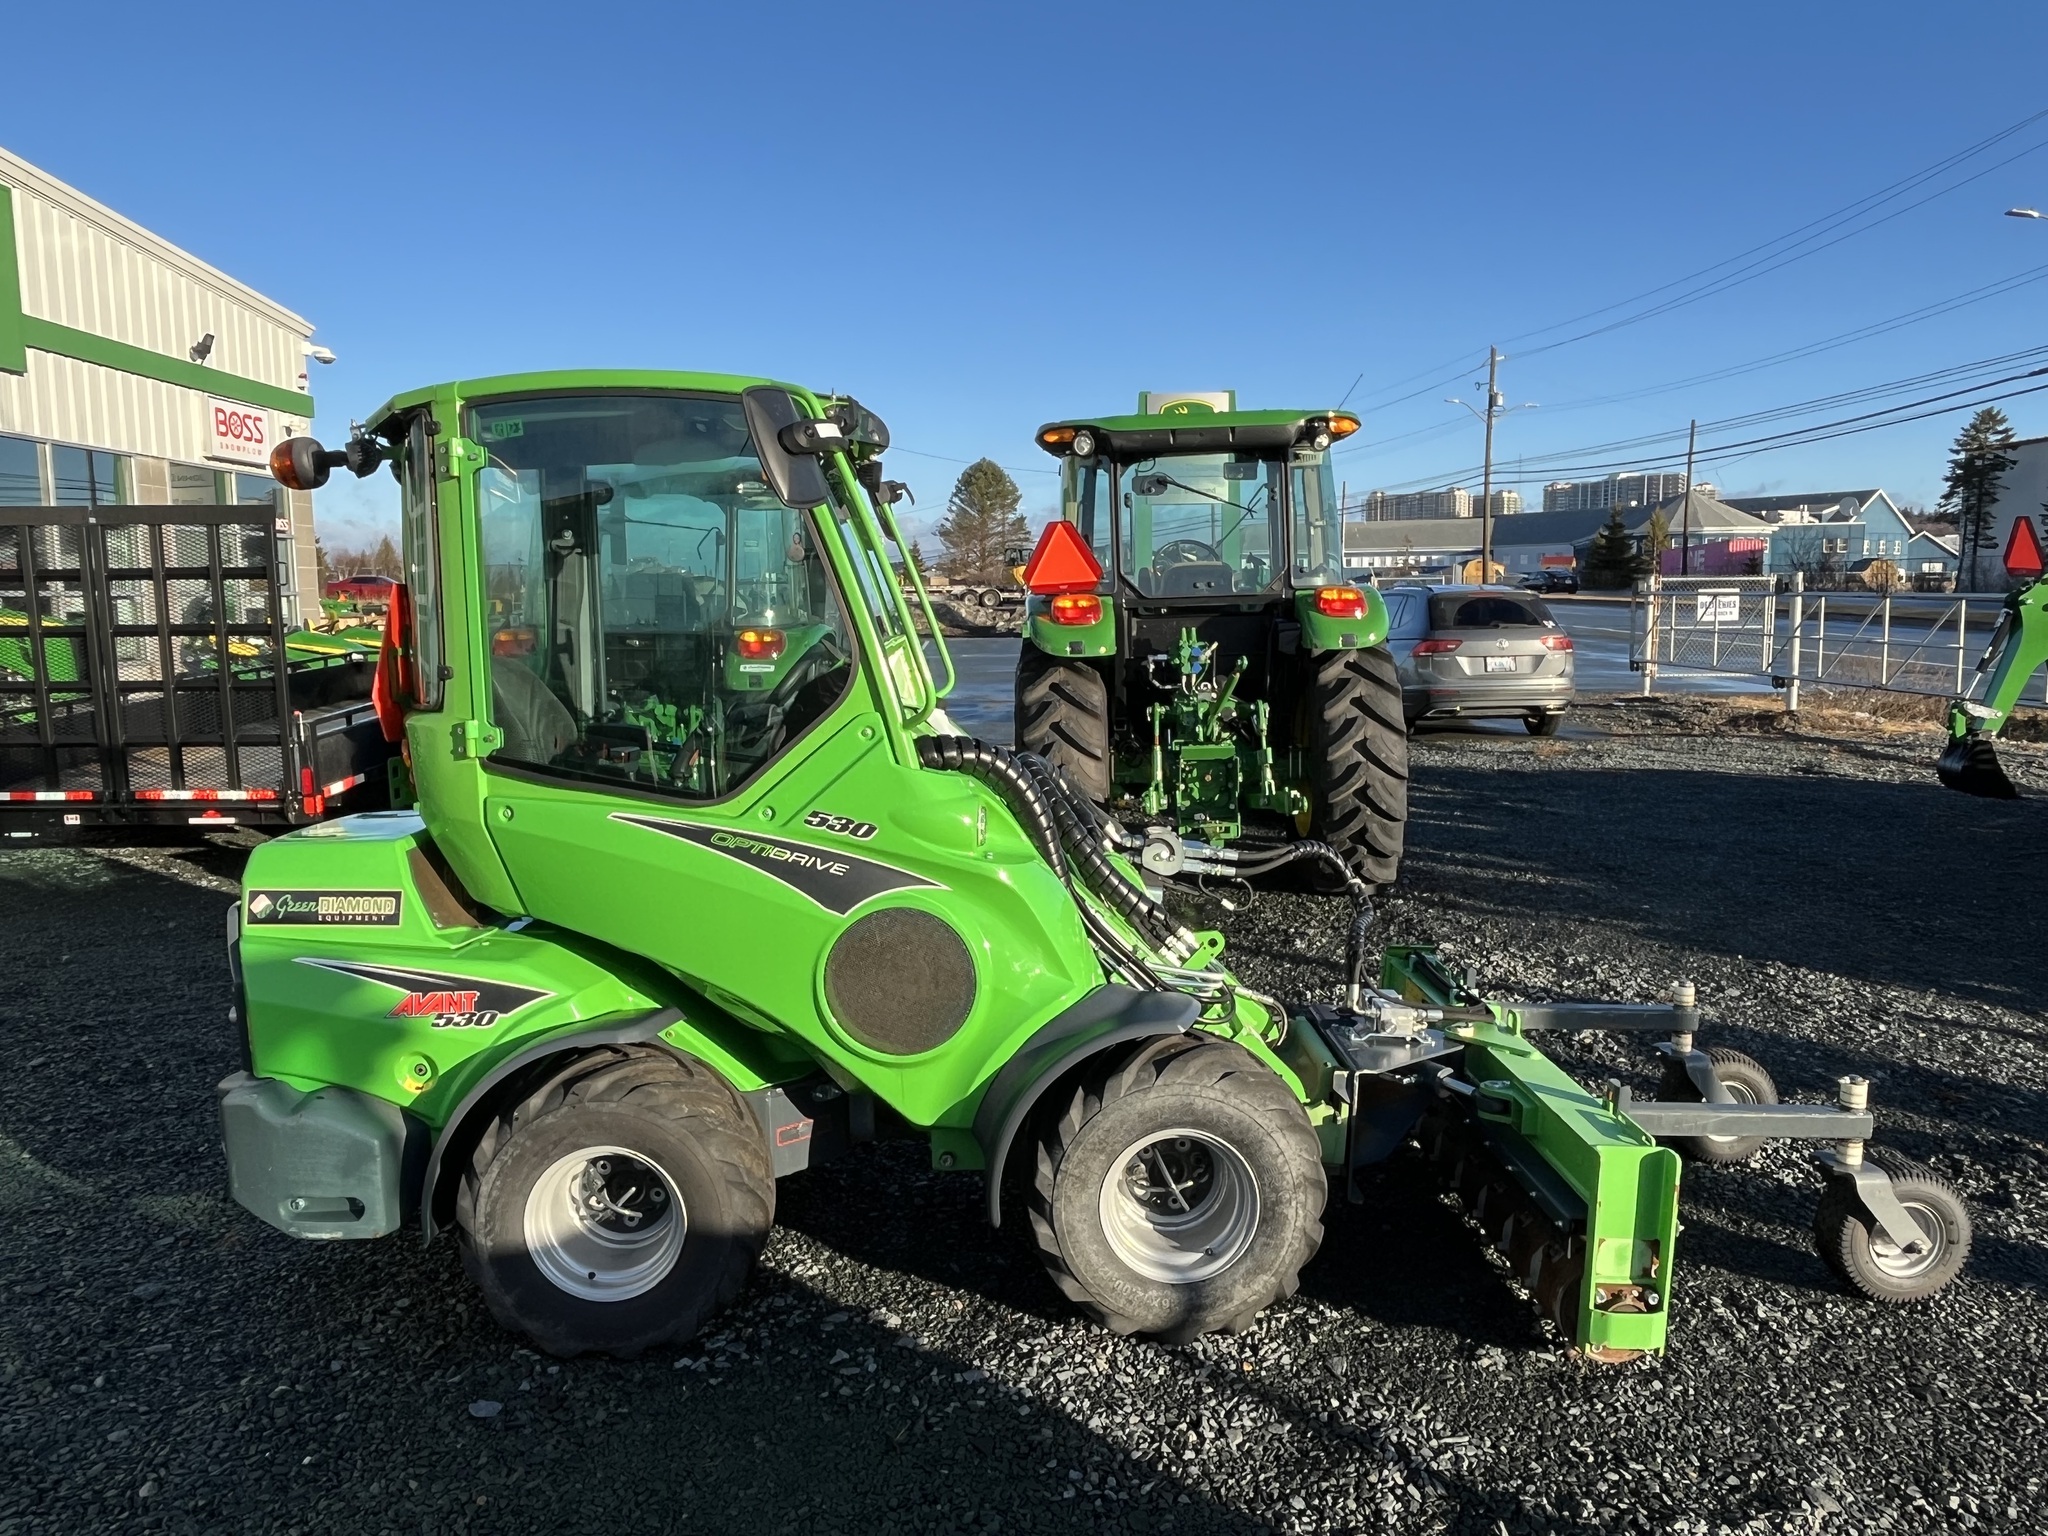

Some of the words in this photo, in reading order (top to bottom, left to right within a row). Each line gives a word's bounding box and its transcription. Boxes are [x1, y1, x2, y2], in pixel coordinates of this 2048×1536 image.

[215, 407, 263, 444] BOSS
[1699, 599, 1737, 609] DELIERIES
[803, 809, 879, 841] 530
[710, 832, 850, 877] OPTIDRIVE
[275, 894, 319, 919] Green
[318, 897, 396, 915] DIAMOND
[385, 991, 480, 1019] AVANT
[431, 1010, 500, 1029] 530
